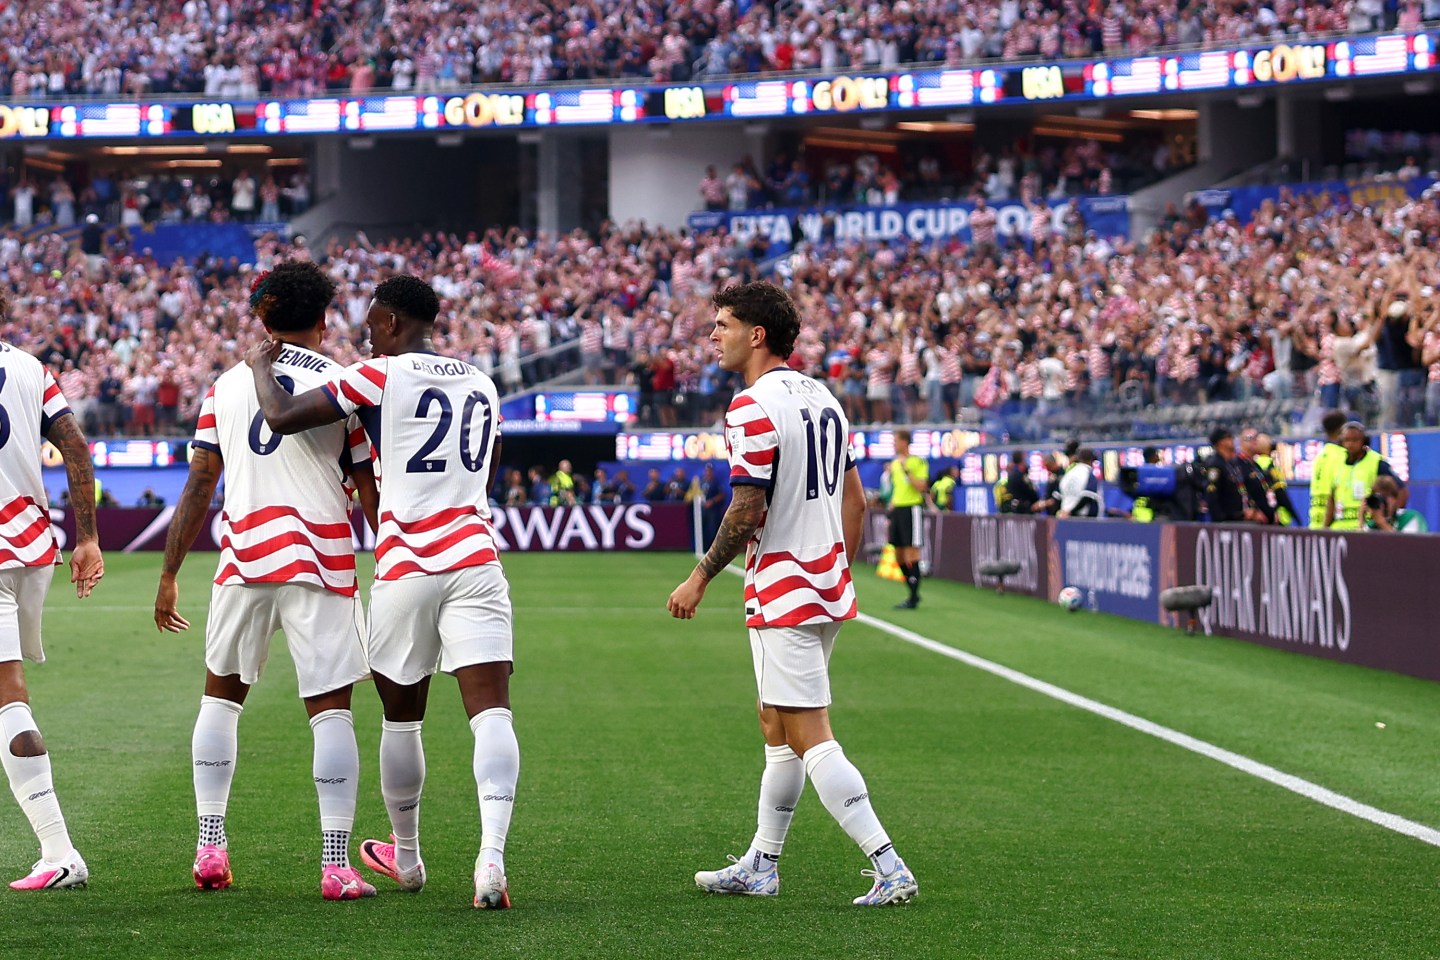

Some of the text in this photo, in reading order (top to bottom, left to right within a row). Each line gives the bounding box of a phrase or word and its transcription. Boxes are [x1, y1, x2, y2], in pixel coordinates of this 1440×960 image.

[1253, 44, 1327, 81] GOAL!
[812, 75, 888, 111] GOAL!
[1022, 67, 1063, 100] USA
[192, 103, 234, 134] USA
[444, 92, 524, 127] GOAL!
[664, 86, 706, 119] USA
[906, 207, 972, 240] CUP
[405, 386, 492, 474] 20
[799, 406, 843, 502] 10
[1195, 528, 1257, 637] QATAR
[1259, 531, 1351, 652] AIRWAYS
